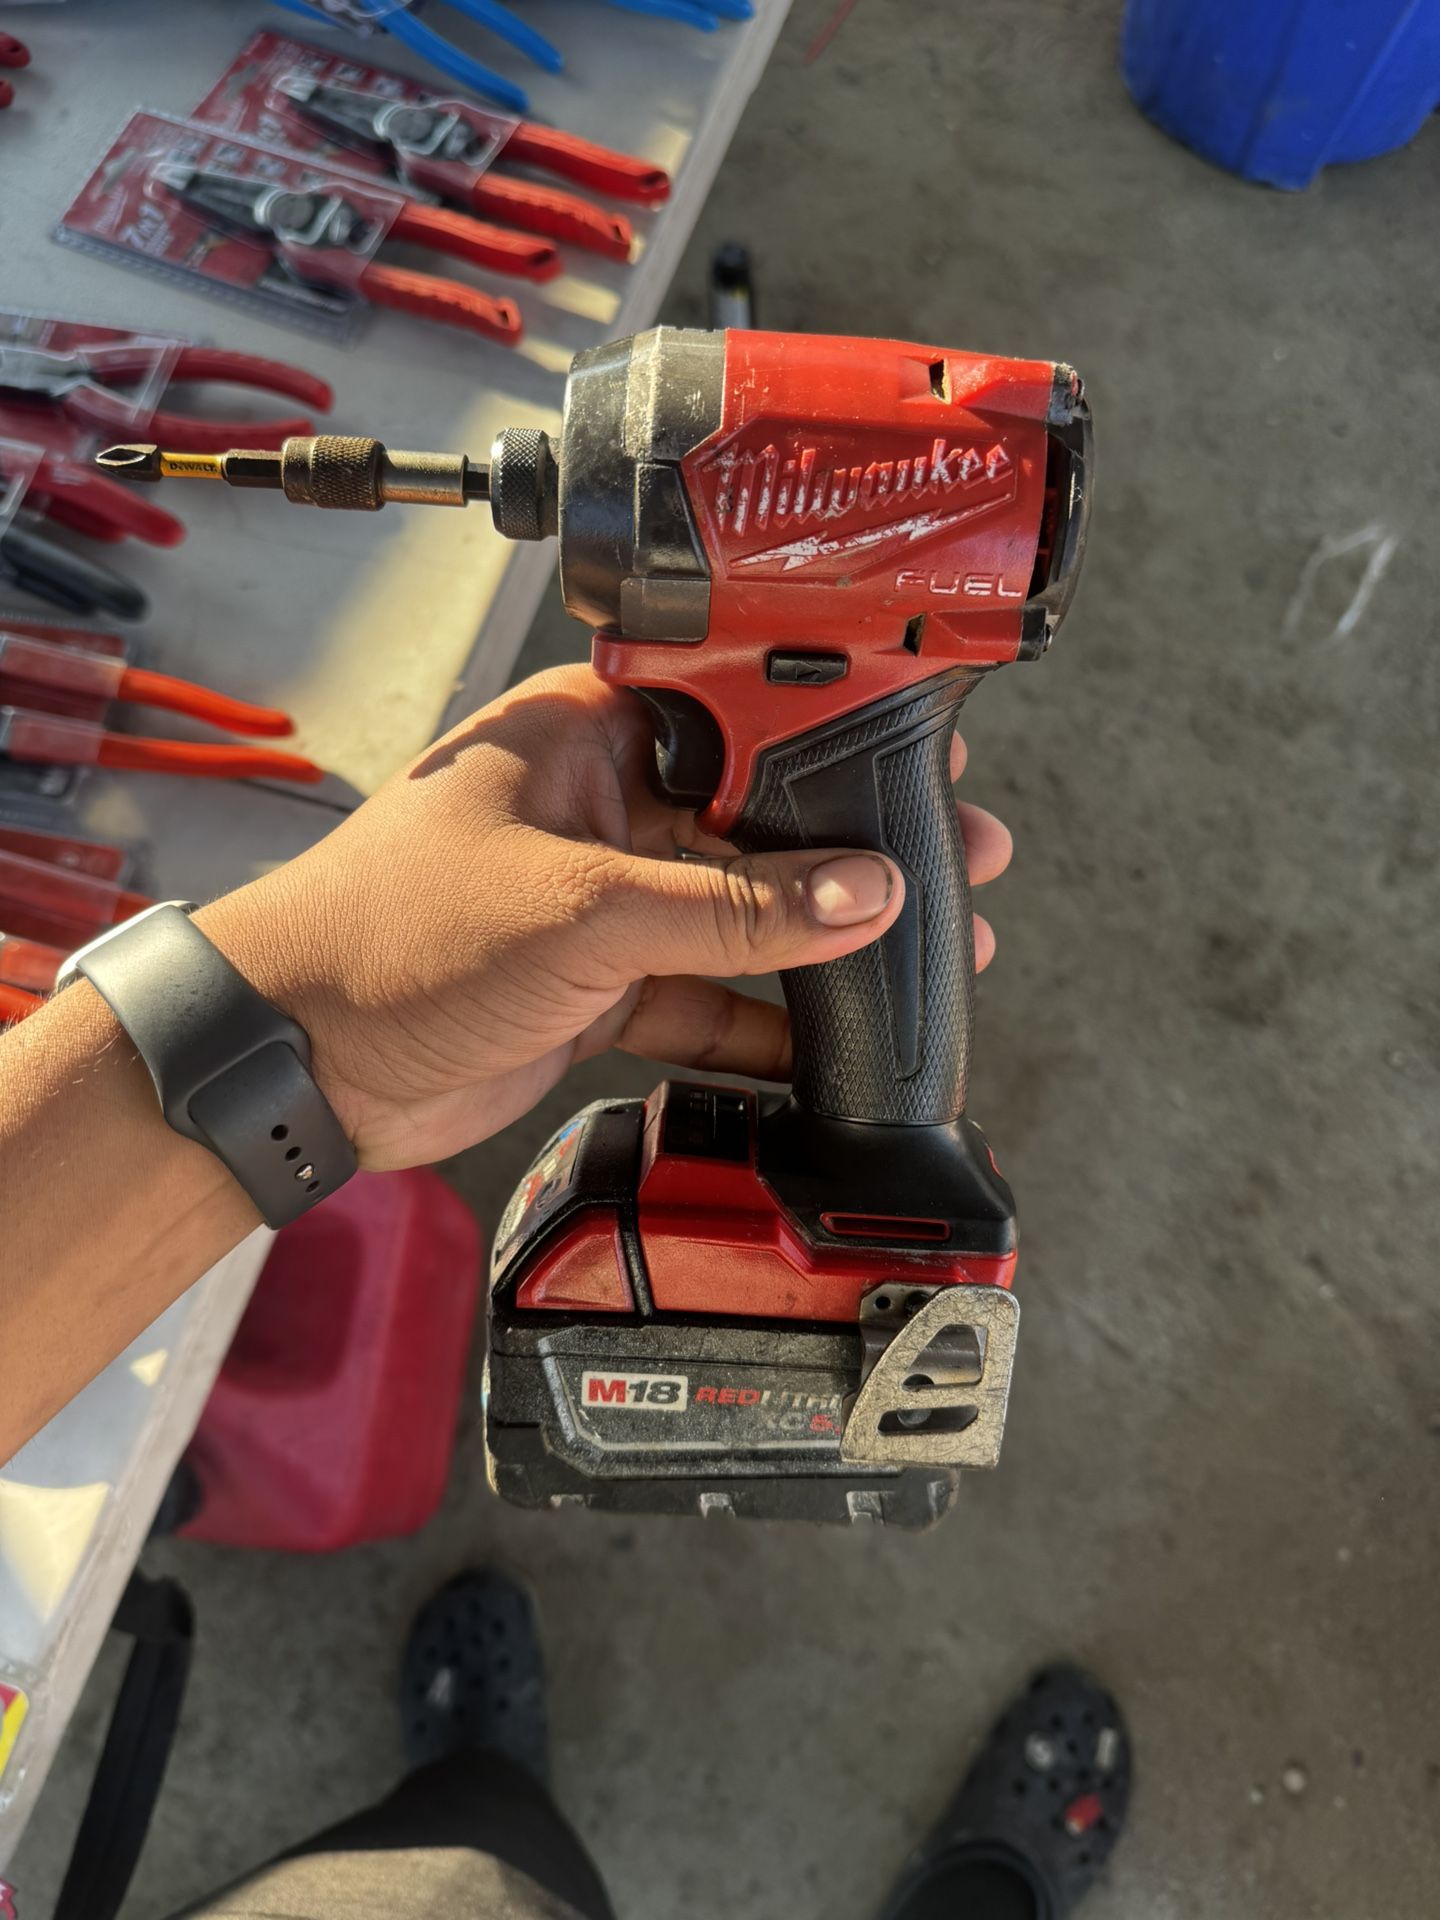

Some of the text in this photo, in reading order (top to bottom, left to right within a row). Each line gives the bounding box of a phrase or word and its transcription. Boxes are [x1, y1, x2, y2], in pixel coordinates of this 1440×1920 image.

[702, 438, 1014, 537] Milwaukee
[894, 568, 1022, 598] FUEL
[588, 1378, 682, 1404] M18
